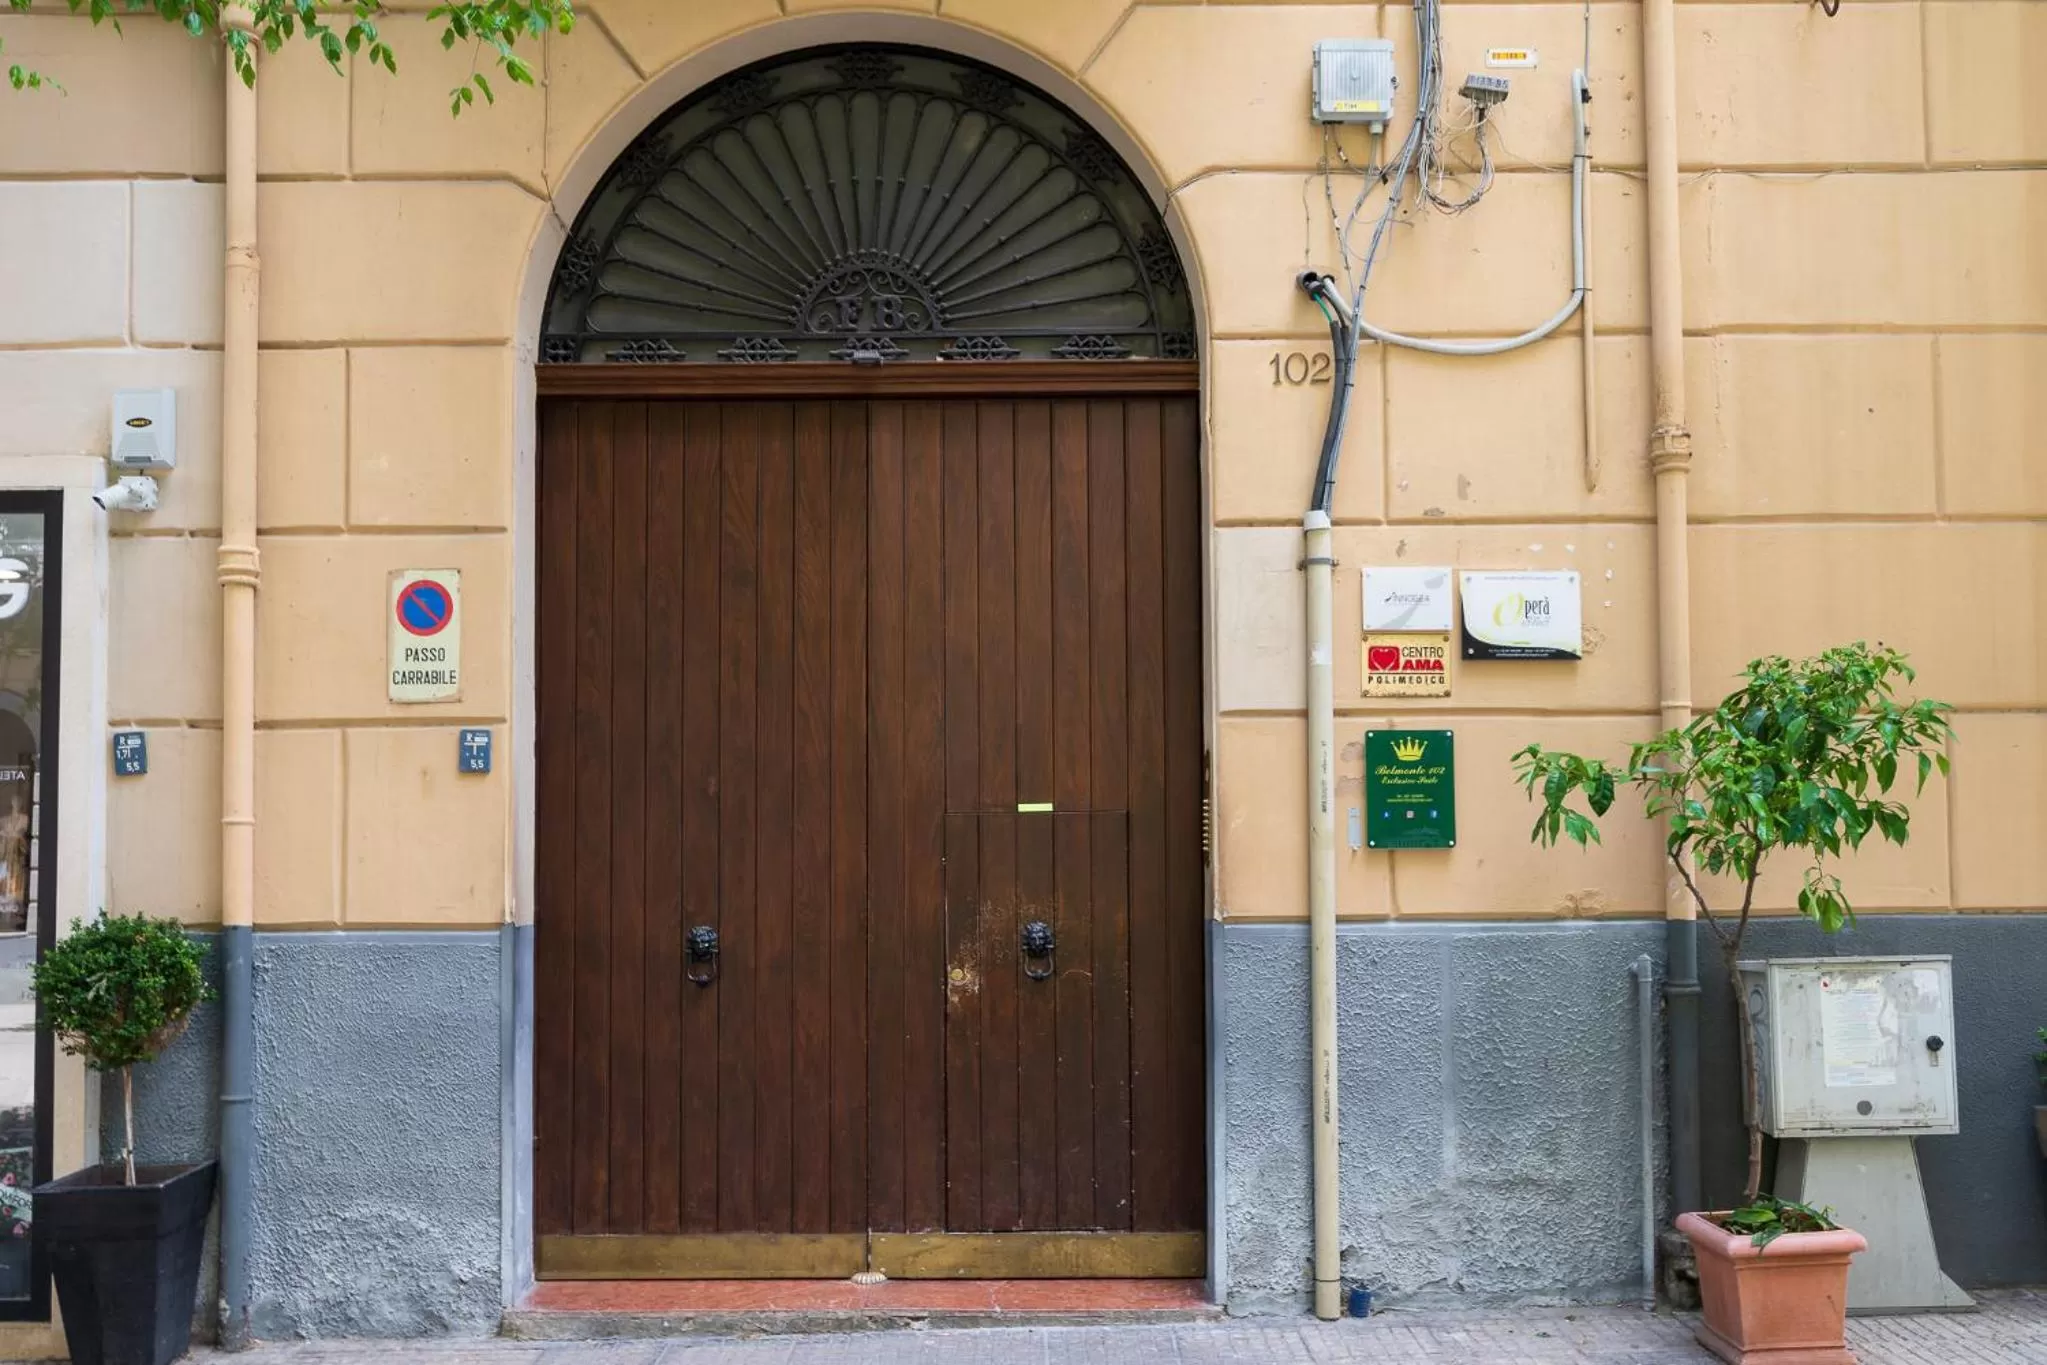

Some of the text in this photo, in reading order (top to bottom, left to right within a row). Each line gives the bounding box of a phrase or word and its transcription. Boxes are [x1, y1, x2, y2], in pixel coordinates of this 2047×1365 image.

[1268, 352, 1331, 386] 102
[405, 647, 446, 662] PASSO
[1402, 646, 1444, 658] CENTRO
[1402, 659, 1445, 671] AMA
[392, 670, 457, 686] CARRABILE
[1368, 675, 1445, 685] POLIMEDICO
